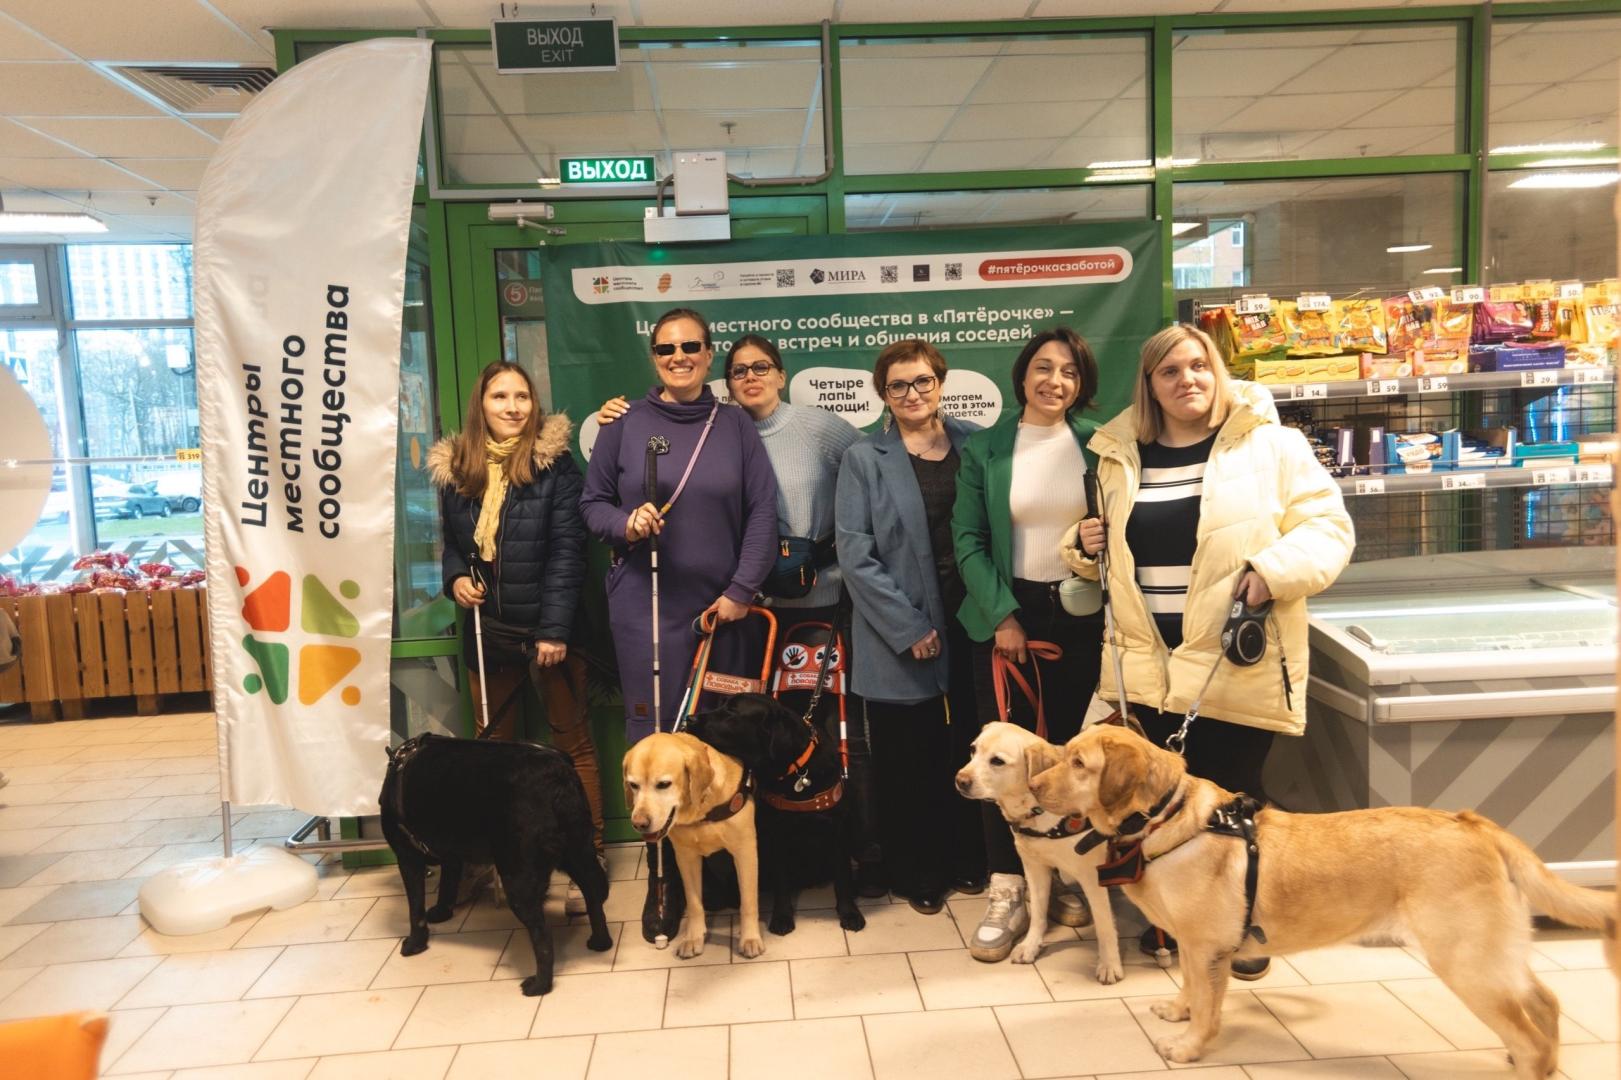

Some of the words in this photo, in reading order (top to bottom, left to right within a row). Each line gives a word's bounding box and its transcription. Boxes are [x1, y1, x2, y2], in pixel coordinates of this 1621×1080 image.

[527, 27, 584, 47] ВЫХОД
[541, 49, 574, 63] EXIT
[567, 159, 647, 180] ВЫХОД
[987, 259, 1116, 275] #пятёрочкасзаботой
[828, 270, 866, 281] МИРА
[797, 312, 913, 329] сообщества
[918, 314, 929, 325] в
[933, 307, 1055, 325] «Пятёрочке»
[778, 335, 842, 352] встреч
[848, 335, 859, 347] и
[956, 324, 1037, 342] соседей.
[809, 379, 864, 391] Четыре
[818, 392, 856, 402] лапы
[942, 394, 983, 402] могаем
[312, 284, 352, 539] сообщества
[806, 401, 870, 413] мощи!
[962, 402, 968, 410] в
[970, 401, 995, 409] этом
[280, 334, 306, 533] местного
[241, 363, 269, 527] Центры
